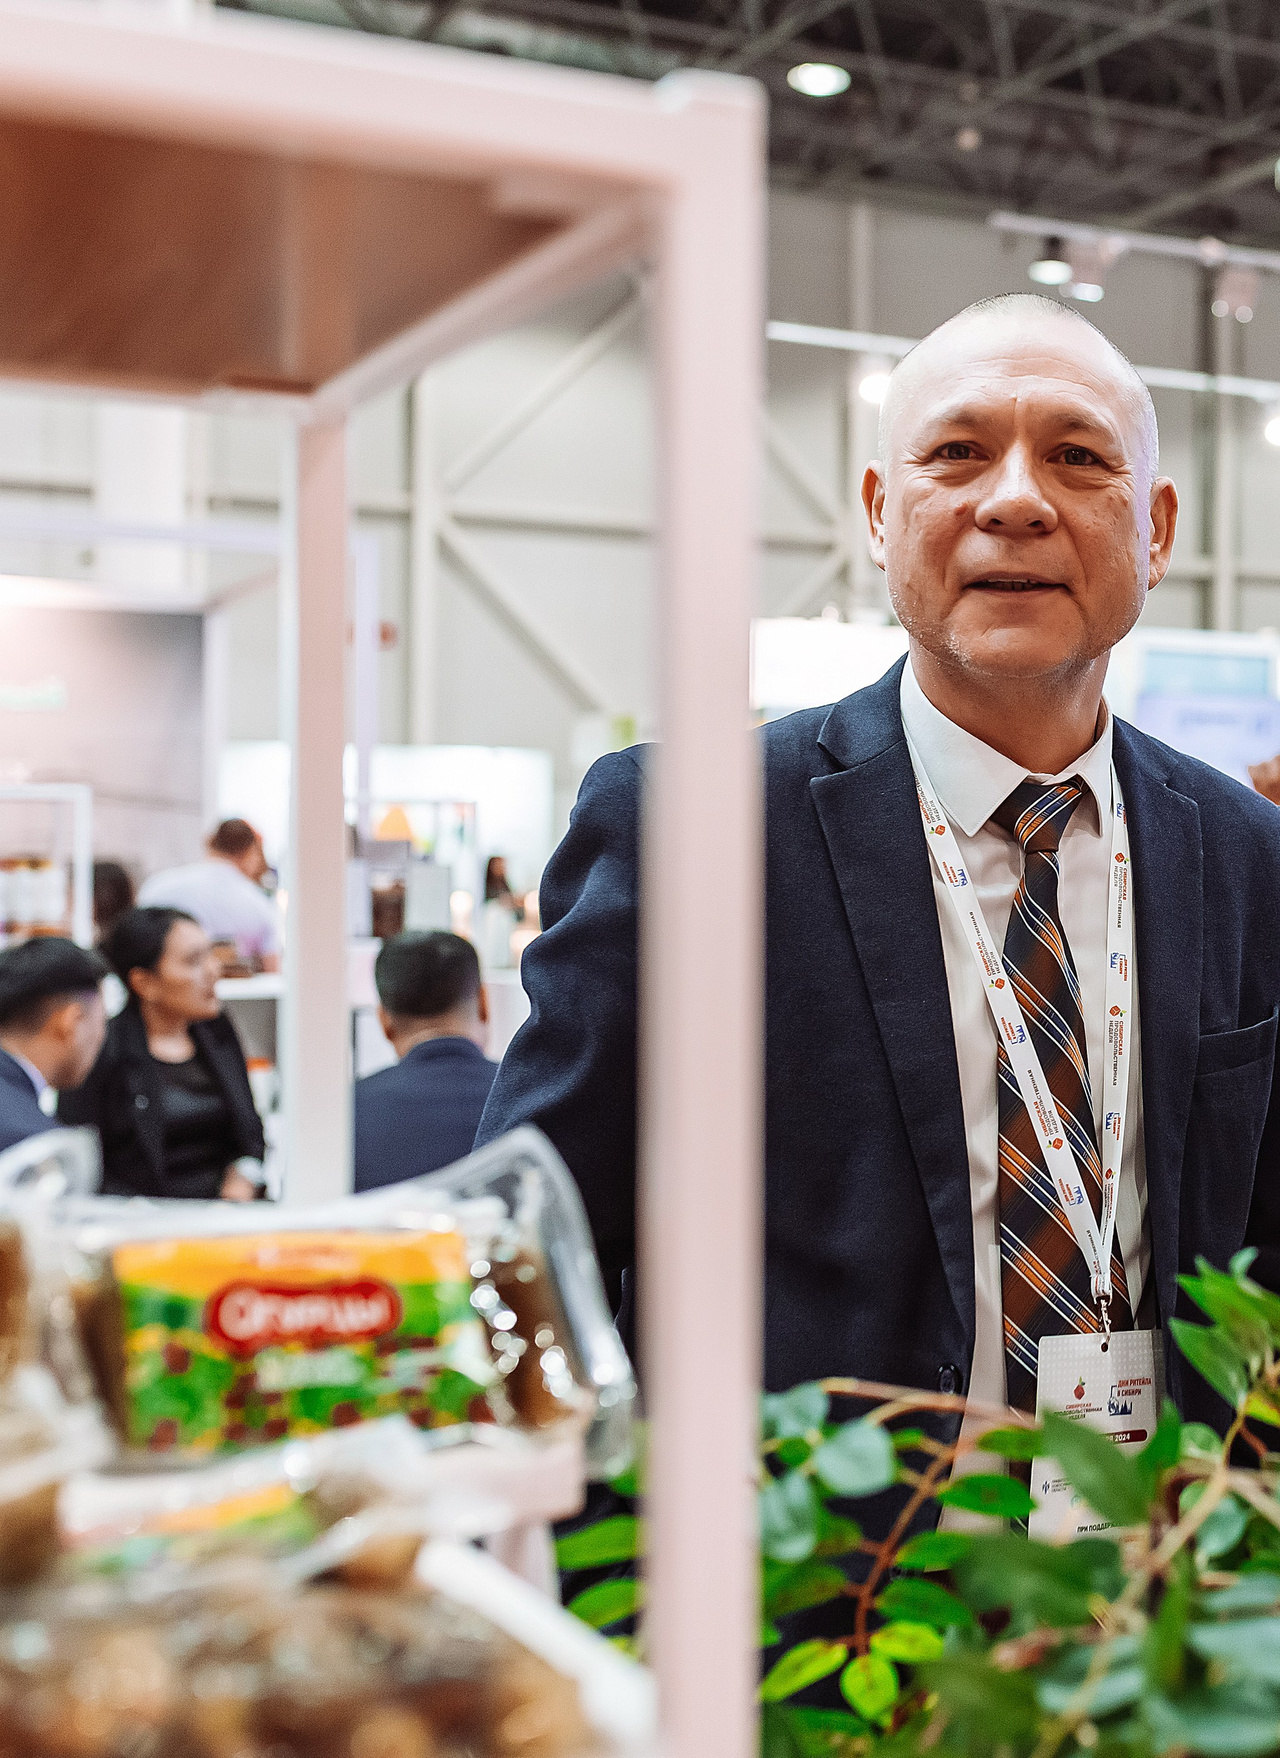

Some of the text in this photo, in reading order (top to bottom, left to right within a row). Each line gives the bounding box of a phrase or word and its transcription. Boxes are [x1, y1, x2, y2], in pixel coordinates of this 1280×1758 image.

[1033, 1101, 1050, 1137] СИБИРСКАЯ
[1118, 1377, 1152, 1388] ДНИ РИТЕЙЛА
[1121, 1388, 1142, 1397] СИБИРИ
[1065, 1402, 1092, 1410] СИБИРСКАЯ
[1115, 1433, 1131, 1442] 2024
[1076, 1525, 1088, 1534] ПРИ
